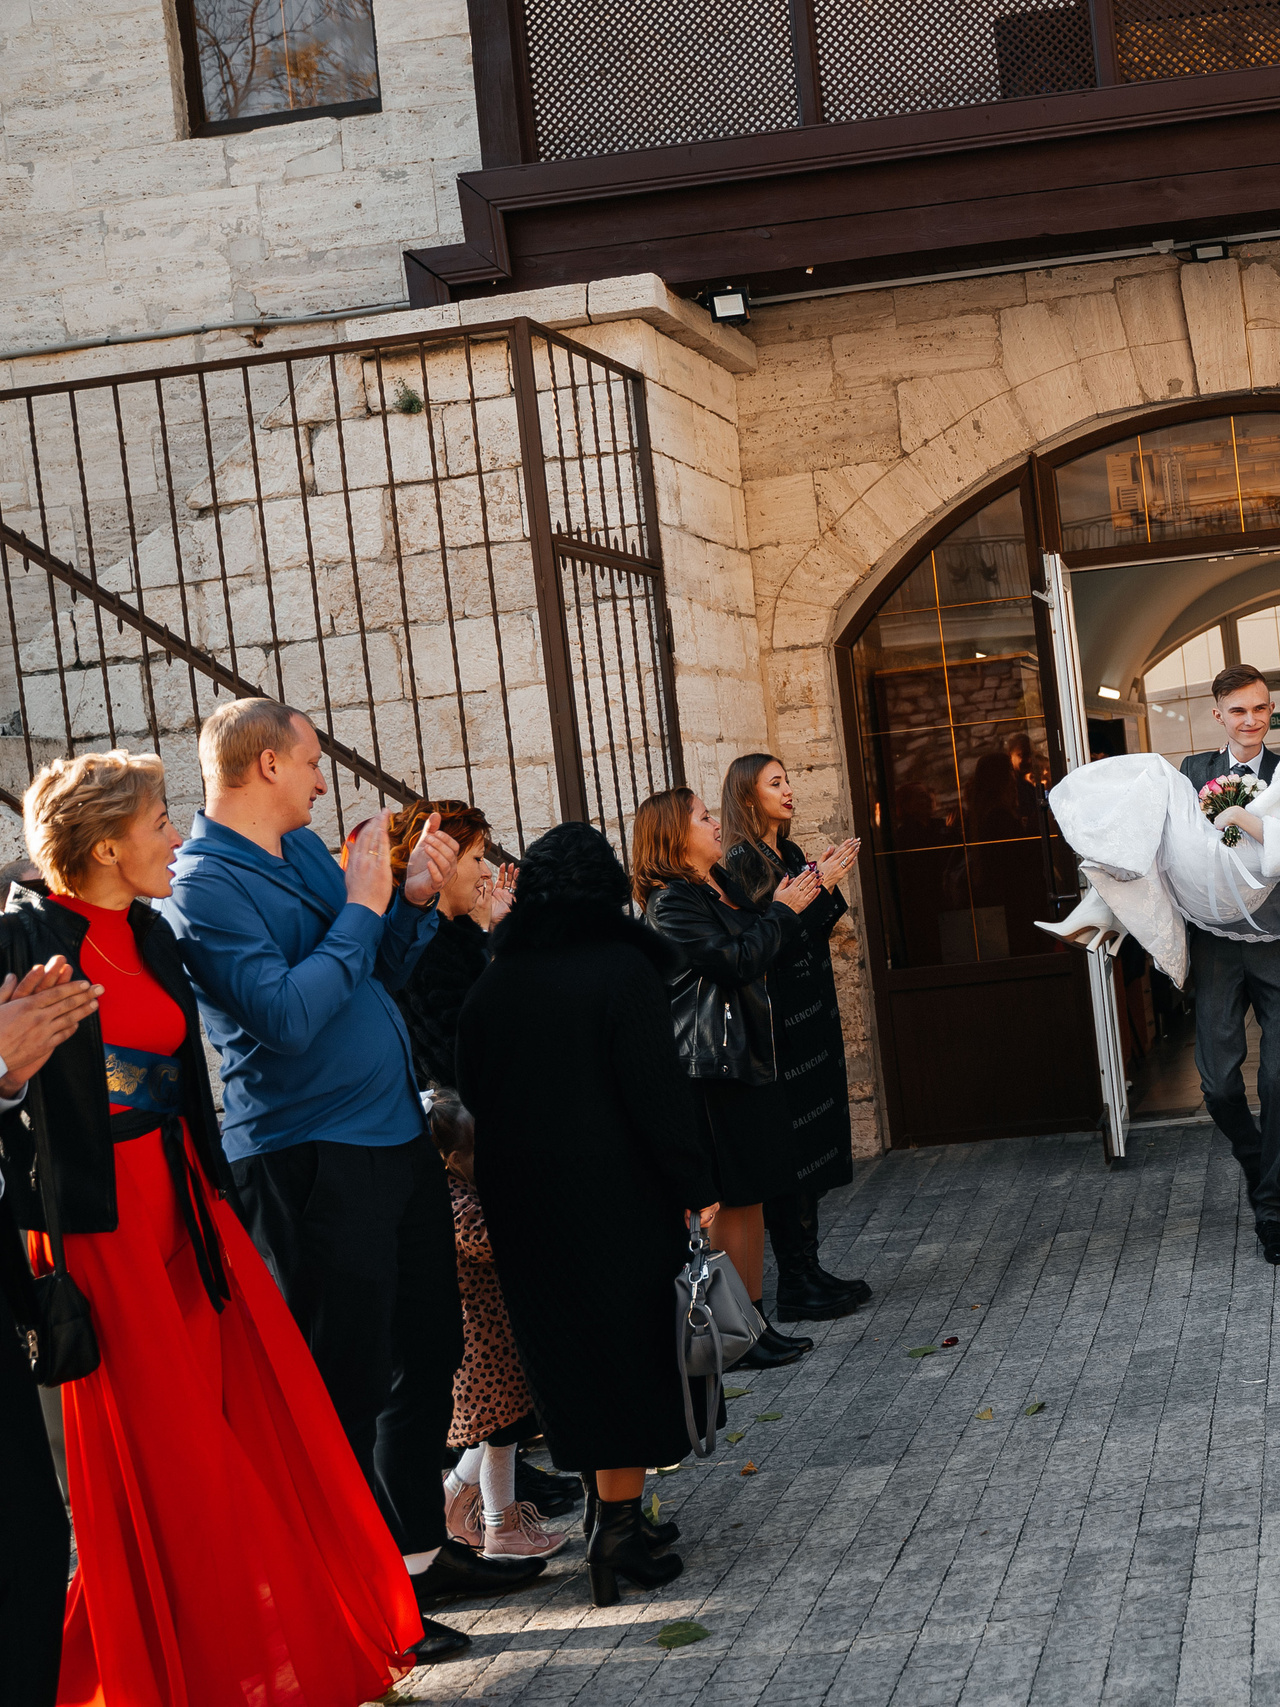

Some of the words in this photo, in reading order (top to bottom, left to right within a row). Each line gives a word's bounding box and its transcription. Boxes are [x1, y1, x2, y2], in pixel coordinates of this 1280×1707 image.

[784, 999, 823, 1028] ALENCIAGA
[784, 1049, 829, 1081] BALENCIAGA
[792, 1097, 835, 1129] BALENCIAGA
[796, 1146, 839, 1180] BALENCIAGA
